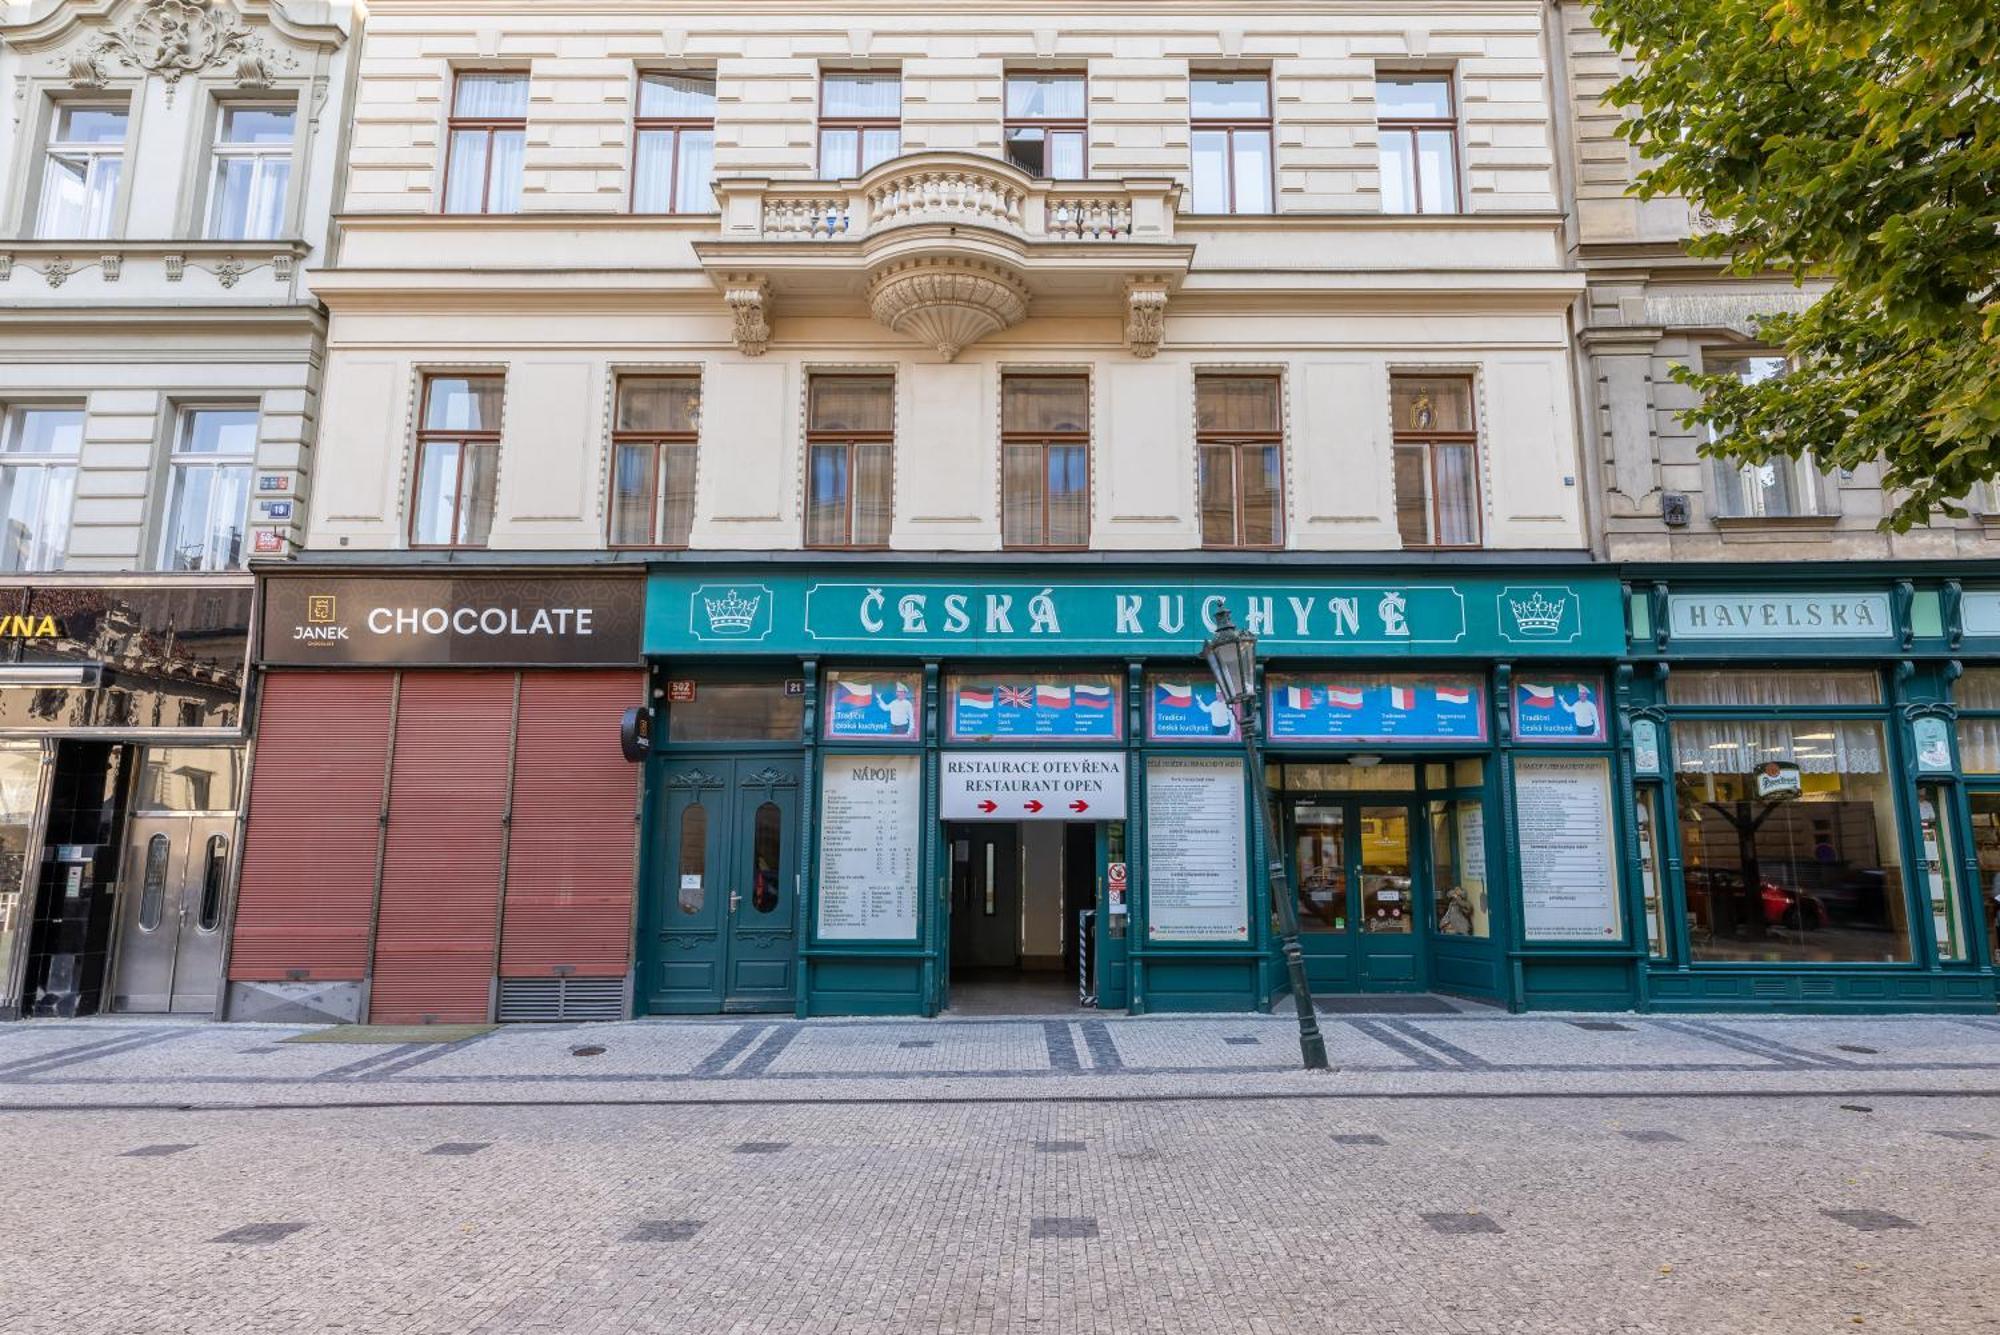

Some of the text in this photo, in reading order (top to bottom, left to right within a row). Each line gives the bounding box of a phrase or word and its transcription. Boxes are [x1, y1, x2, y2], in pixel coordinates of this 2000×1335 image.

[860, 588, 1410, 636] ČESKÁ KUCHYNĚ
[1689, 600, 1875, 627] HAVELSKÁ
[367, 607, 593, 635] CHOCOLATE
[293, 626, 349, 640] JANEK
[790, 683, 801, 692] 21
[948, 759, 1120, 773] RESTAURACE OTEVŘENA
[852, 766, 897, 783] NÁPOJE
[966, 780, 1103, 792] RESTAURANT OPEN
